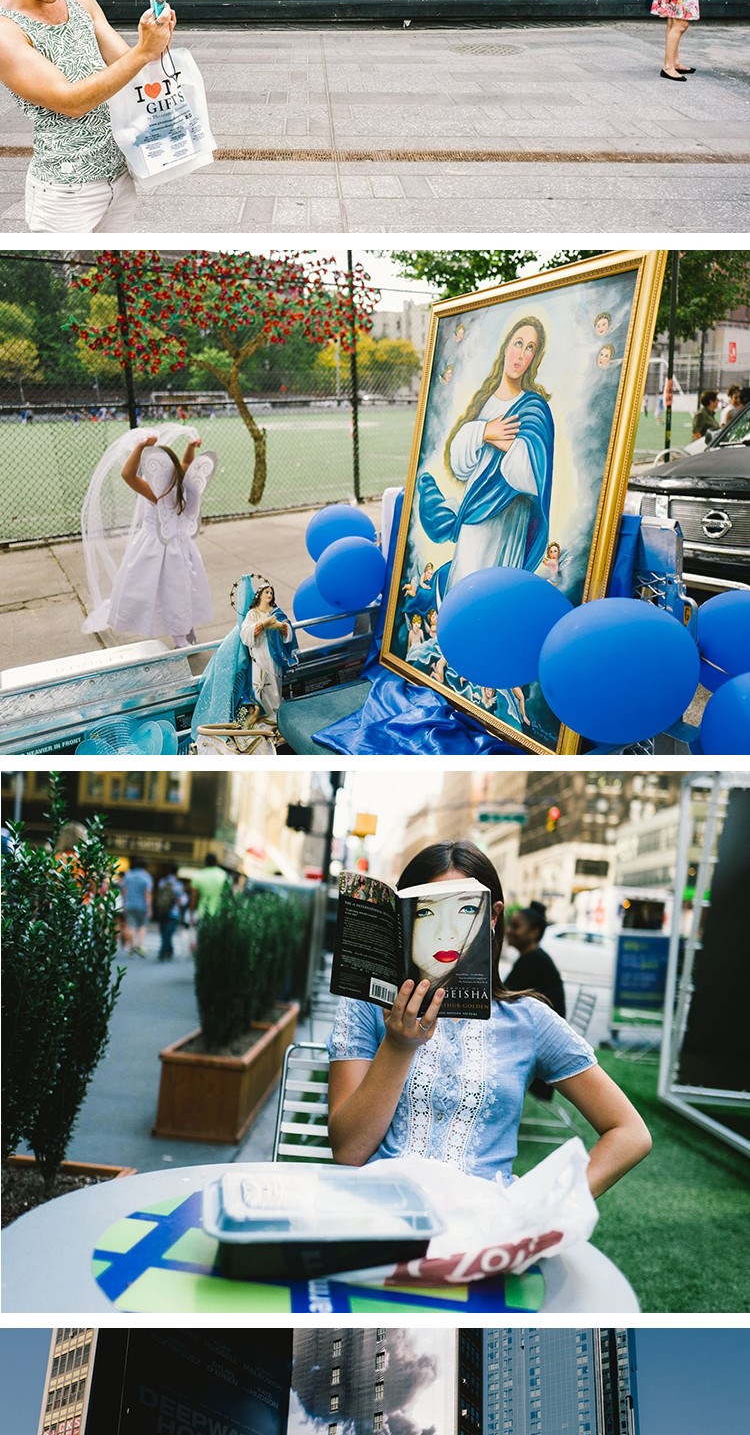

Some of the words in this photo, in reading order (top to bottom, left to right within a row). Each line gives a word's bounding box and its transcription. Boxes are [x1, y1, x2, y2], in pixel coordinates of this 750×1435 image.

[146, 91, 185, 114] GIFTS
[61, 737, 81, 748] FRONT
[249, 1390, 279, 1409] HUDSON
